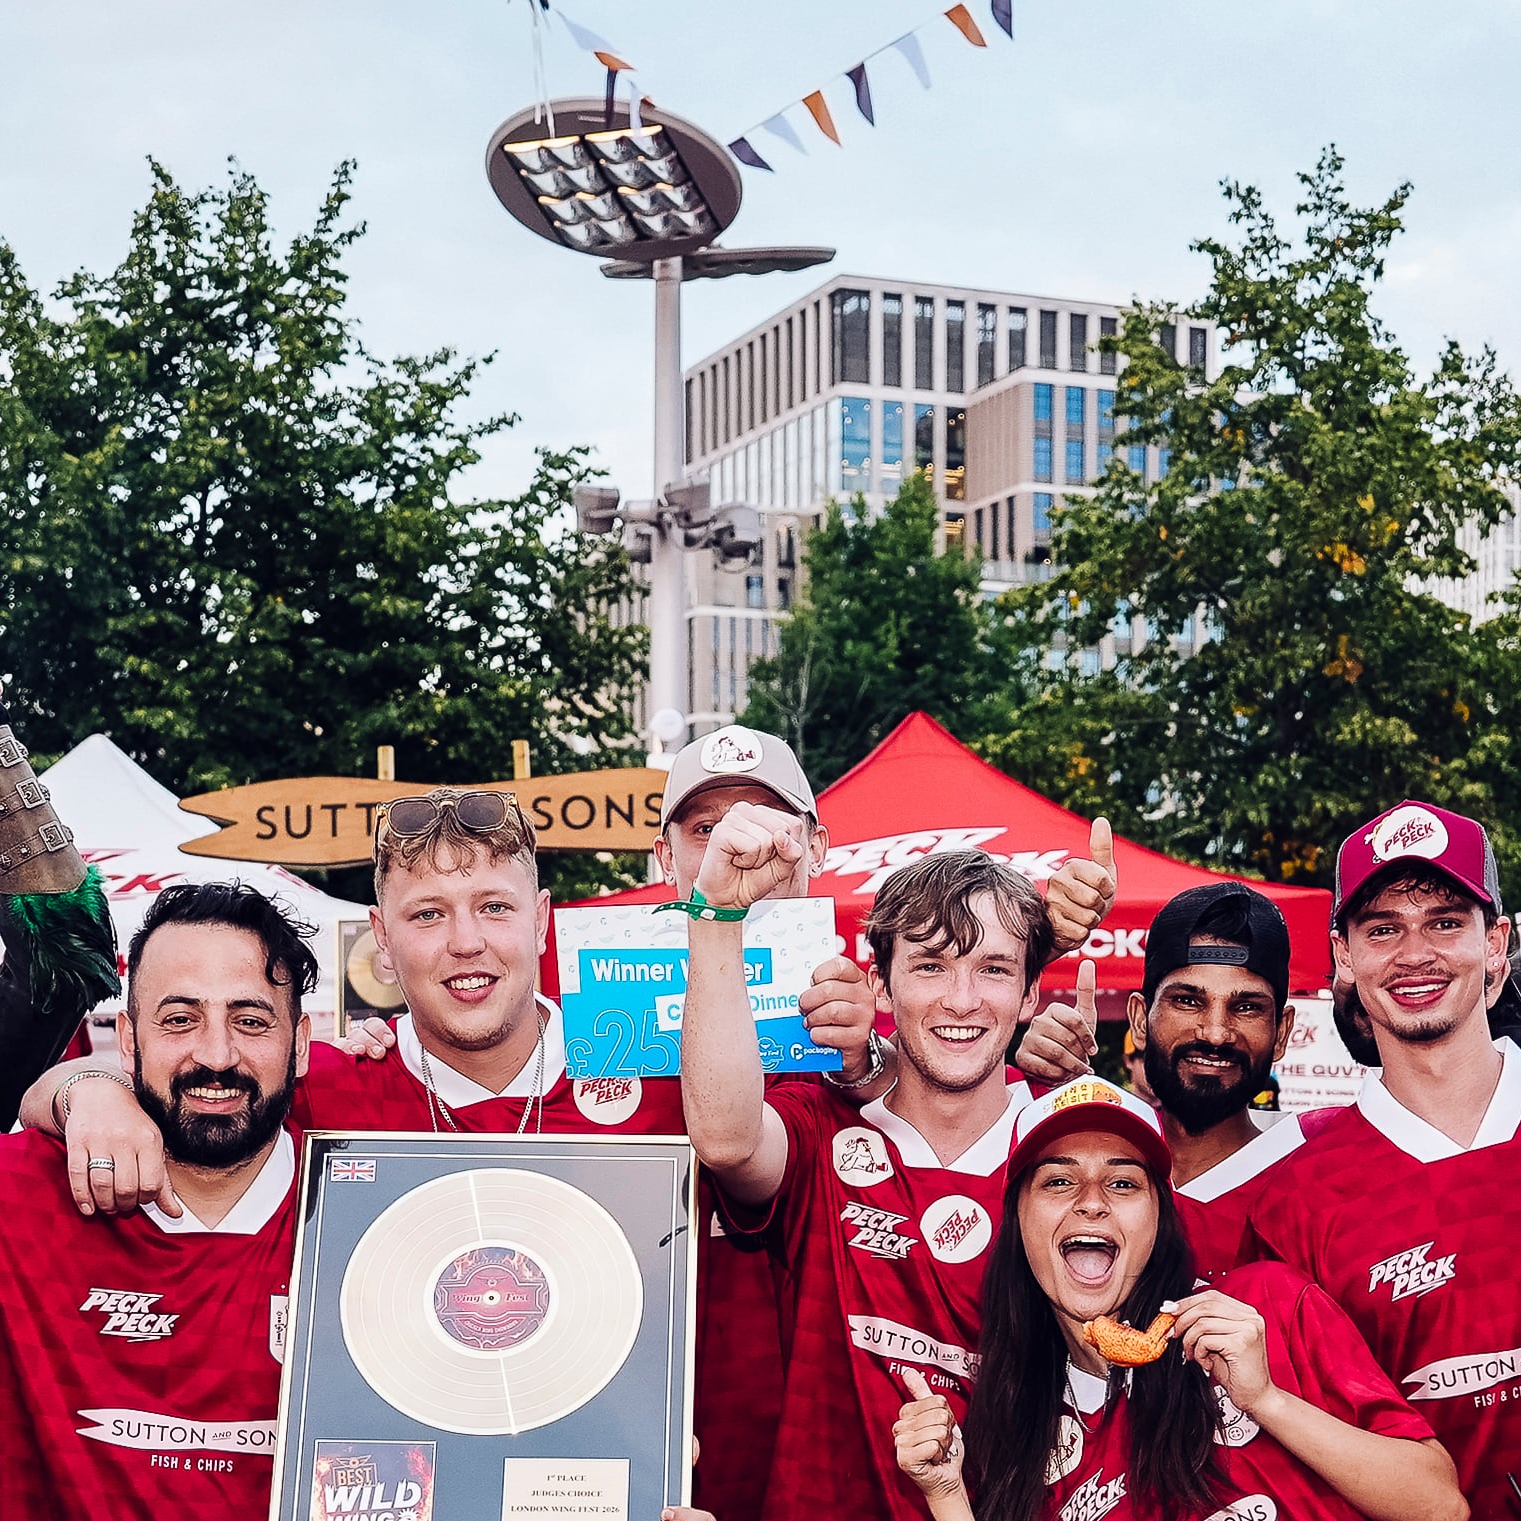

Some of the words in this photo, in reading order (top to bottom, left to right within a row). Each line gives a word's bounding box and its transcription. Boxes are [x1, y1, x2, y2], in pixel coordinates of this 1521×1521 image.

[256, 802, 378, 841] SUTT
[536, 792, 663, 831] SONS
[1384, 818, 1415, 853] PECK
[1401, 822, 1435, 849] PECK
[591, 958, 673, 982] Winner
[751, 994, 797, 1012] Dinne
[1291, 1024, 1318, 1043] CK
[596, 1083, 632, 1101] PECK
[841, 1204, 908, 1231] PECK
[849, 1227, 919, 1256] PECK
[1369, 1247, 1430, 1293] PECK
[1392, 1254, 1457, 1301] PECK
[79, 1289, 161, 1314] PECK
[102, 1313, 181, 1335] PECK
[863, 1325, 940, 1361] SUTTON
[1429, 1356, 1515, 1391] SUTTON
[1500, 1391, 1507, 1402] &
[111, 1420, 206, 1445] SUTTON
[212, 1431, 232, 1440] AND
[236, 1430, 277, 1447] SON
[150, 1454, 179, 1469] FISH
[183, 1458, 192, 1471] &
[197, 1458, 234, 1473] CHIPS
[337, 1468, 372, 1486] BEST
[325, 1479, 422, 1514] WILD
[531, 1490, 566, 1498] JUDGES
[567, 1490, 603, 1498] CHOICE
[511, 1505, 549, 1513] LONDON
